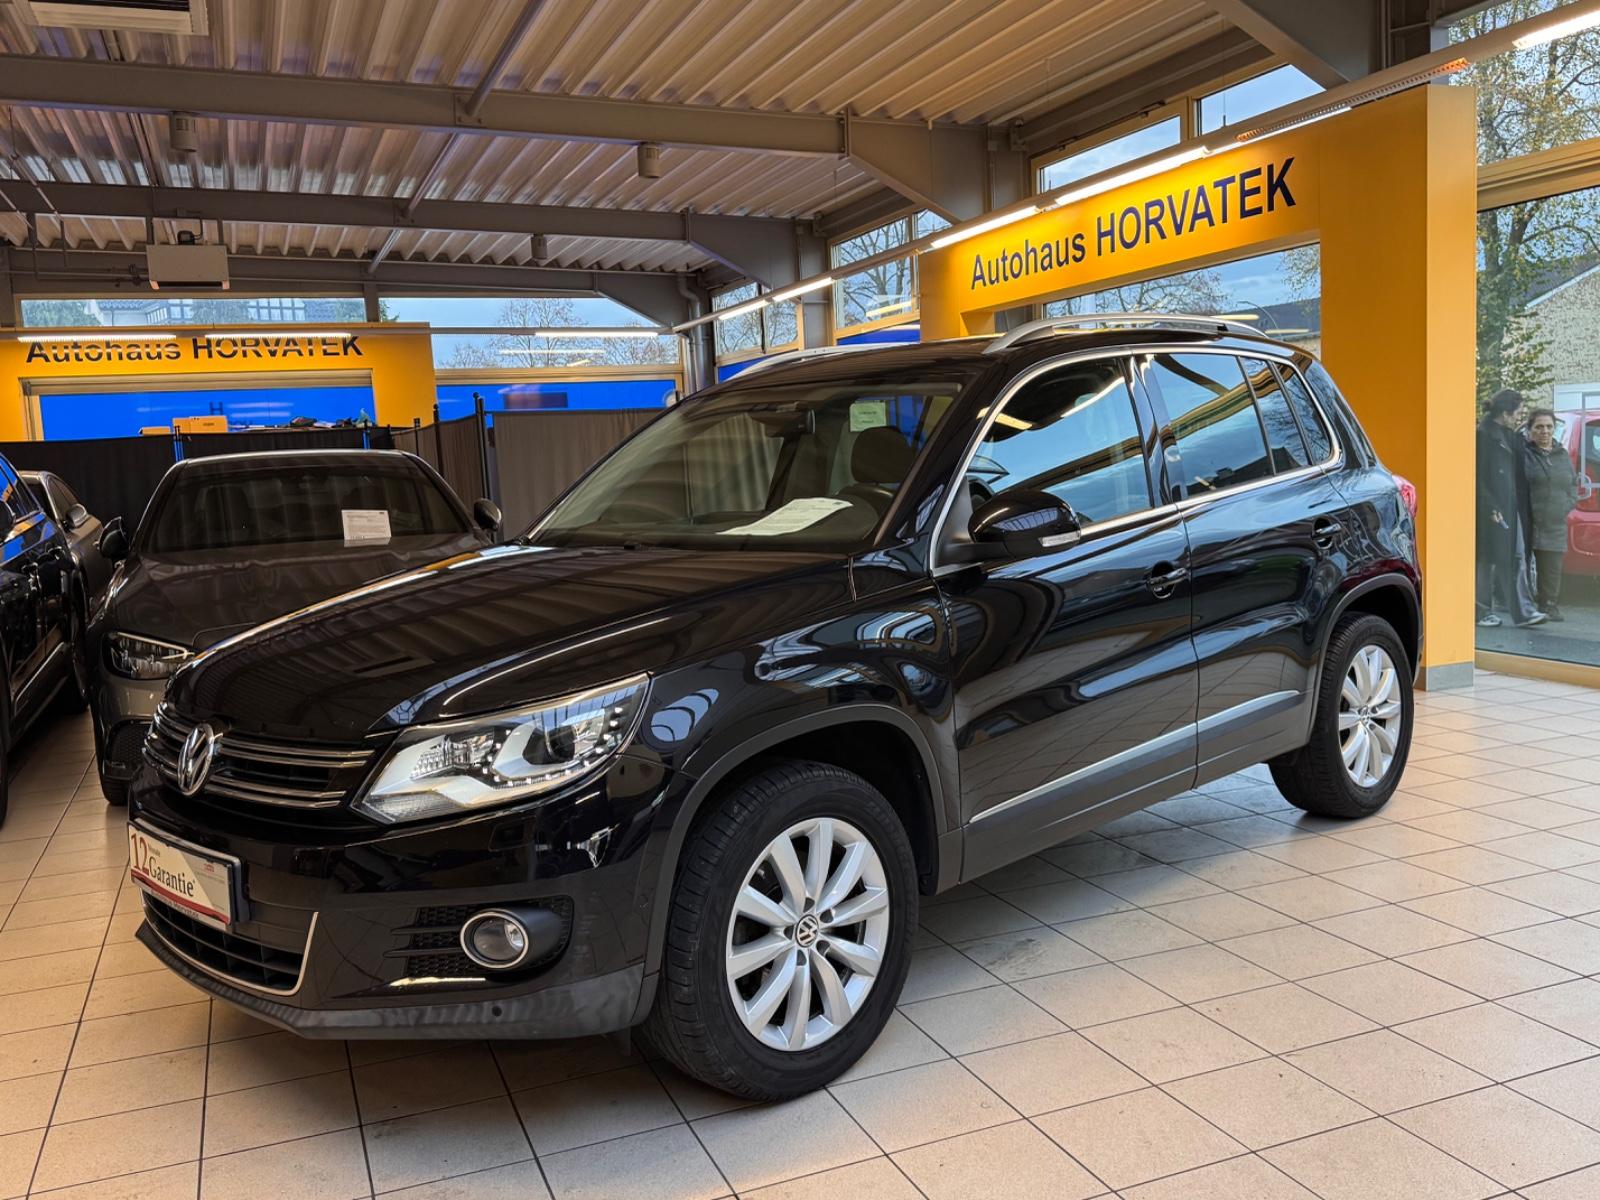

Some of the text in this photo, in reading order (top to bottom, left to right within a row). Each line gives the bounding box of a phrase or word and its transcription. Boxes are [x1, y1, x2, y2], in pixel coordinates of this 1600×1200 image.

[970, 157, 1297, 290] Autohaus HORVATEK
[26, 339, 181, 363] Autohaus
[131, 832, 149, 877] 12
